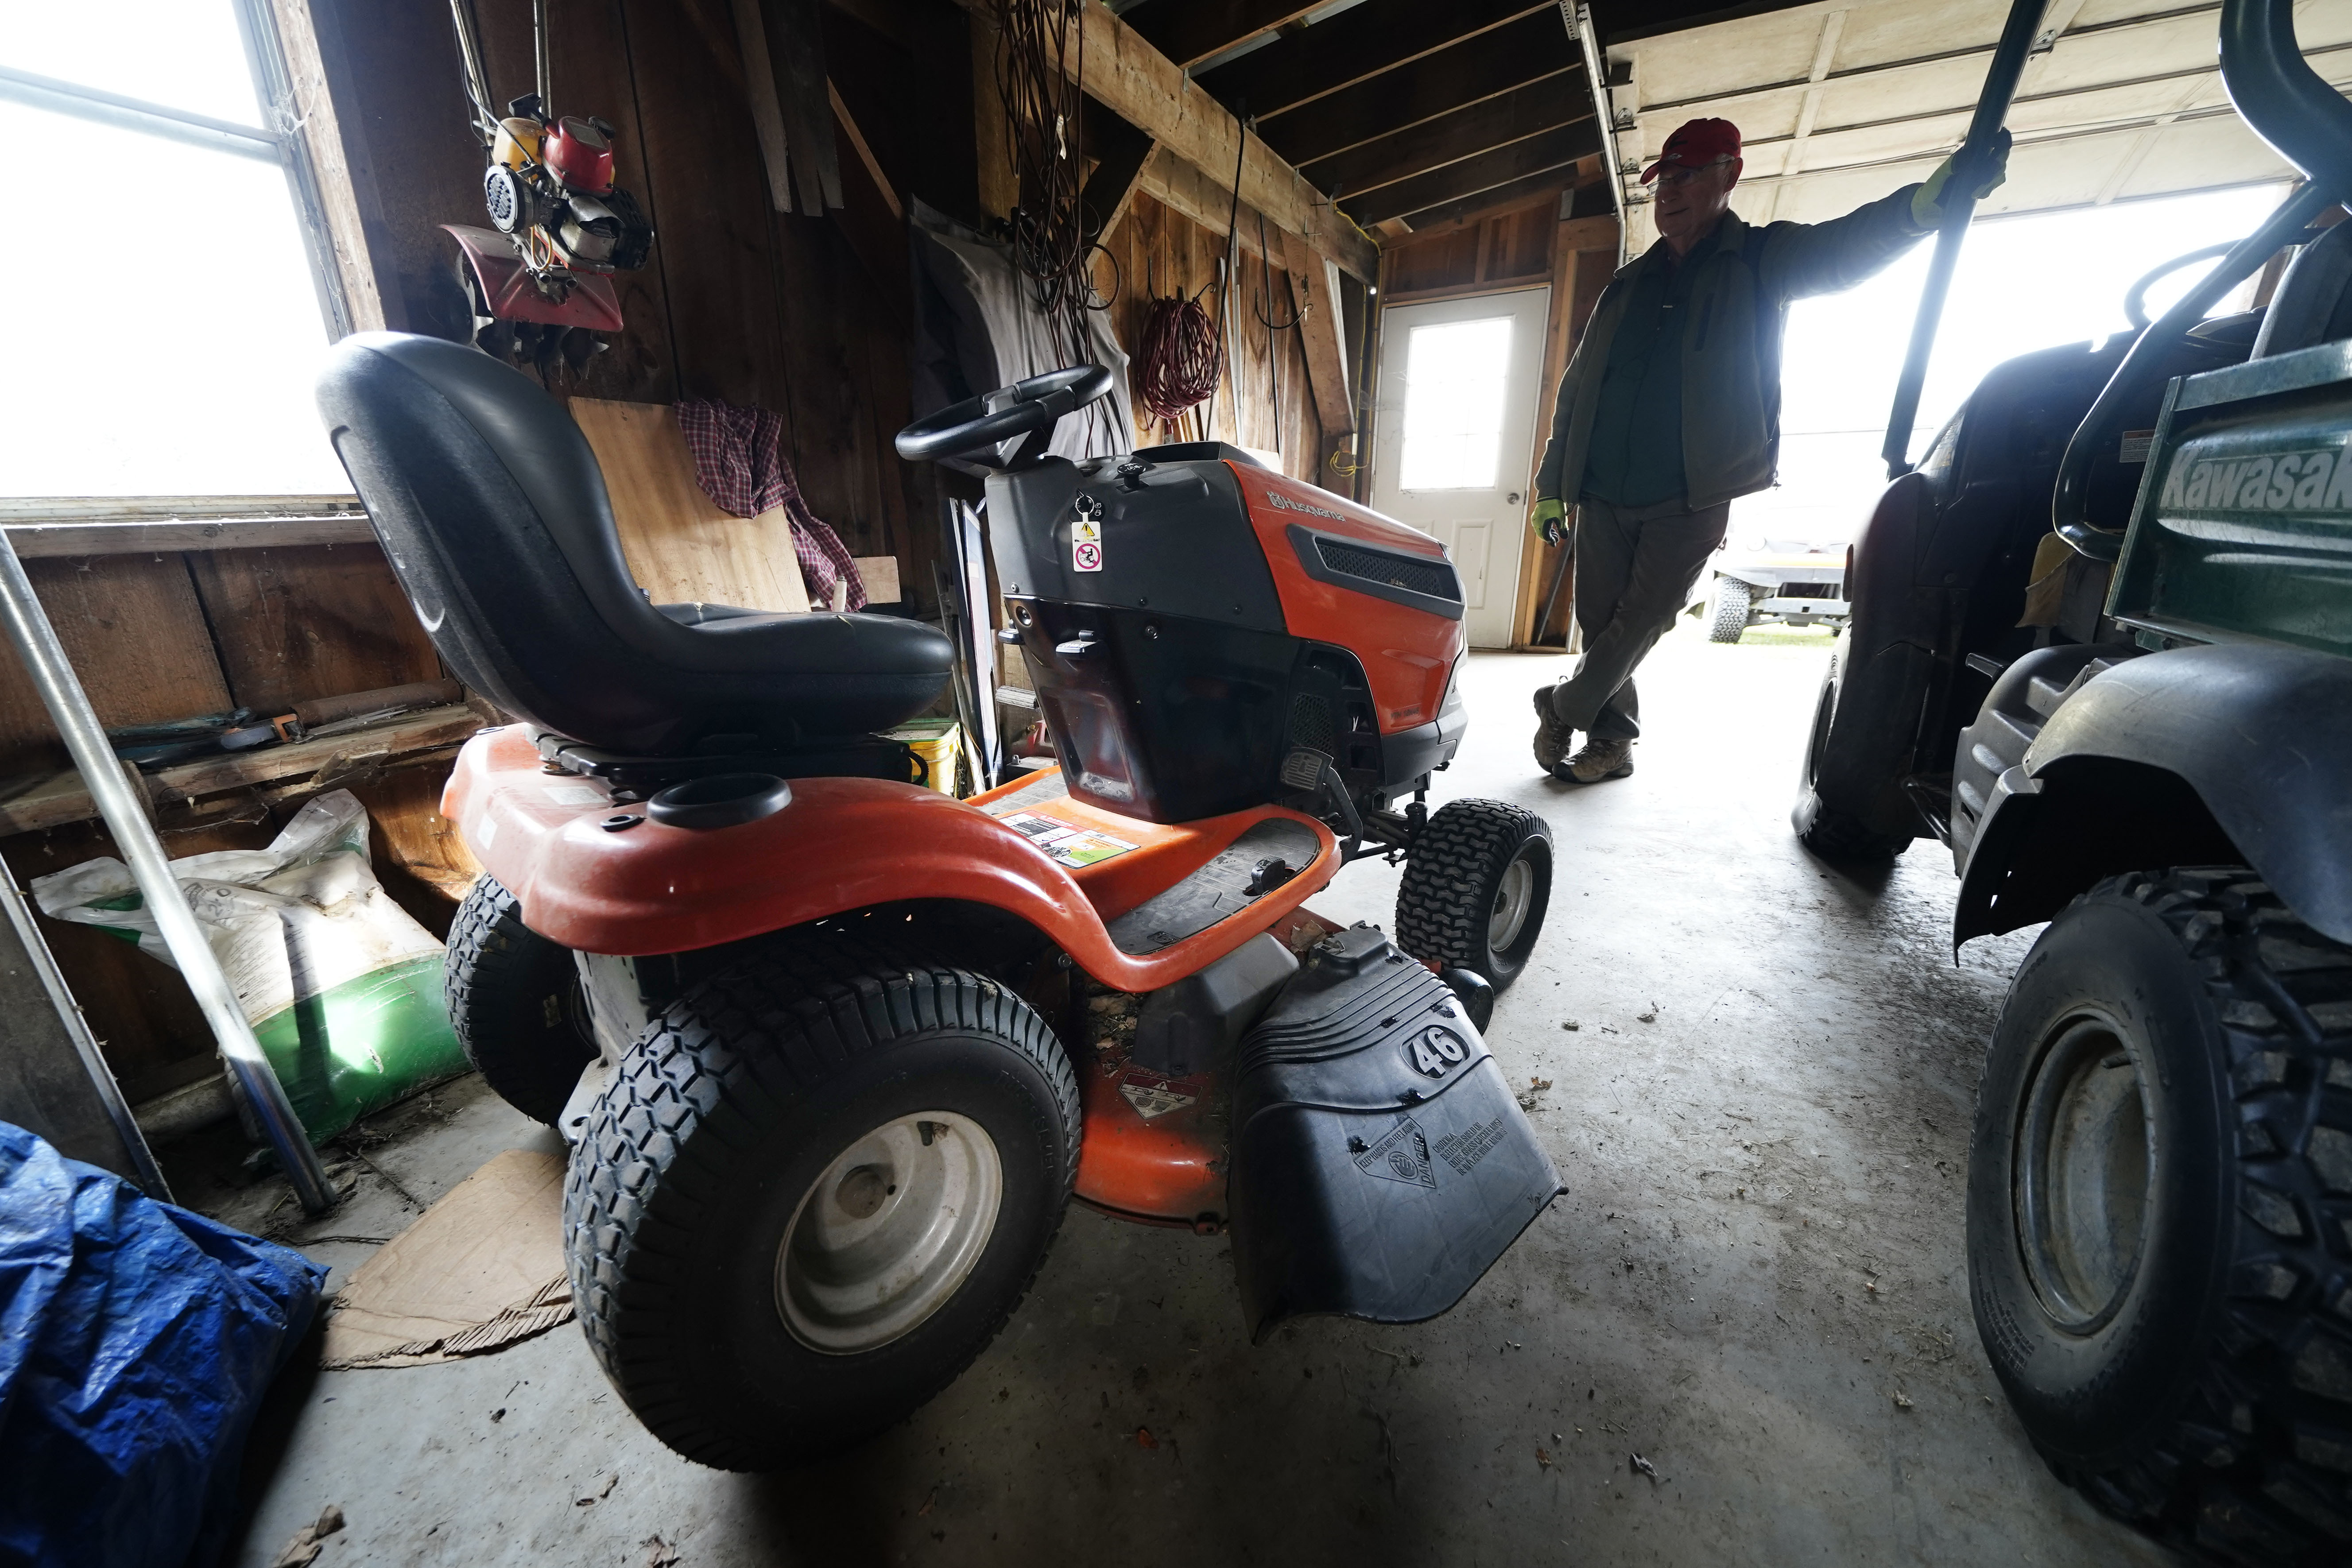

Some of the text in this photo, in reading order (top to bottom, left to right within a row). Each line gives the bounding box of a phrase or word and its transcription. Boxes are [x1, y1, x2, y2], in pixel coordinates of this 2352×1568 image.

[1283, 496, 1346, 522] Husqvarna
[1412, 1027, 1463, 1075] 46
[1413, 1137, 1432, 1184] DANGER
